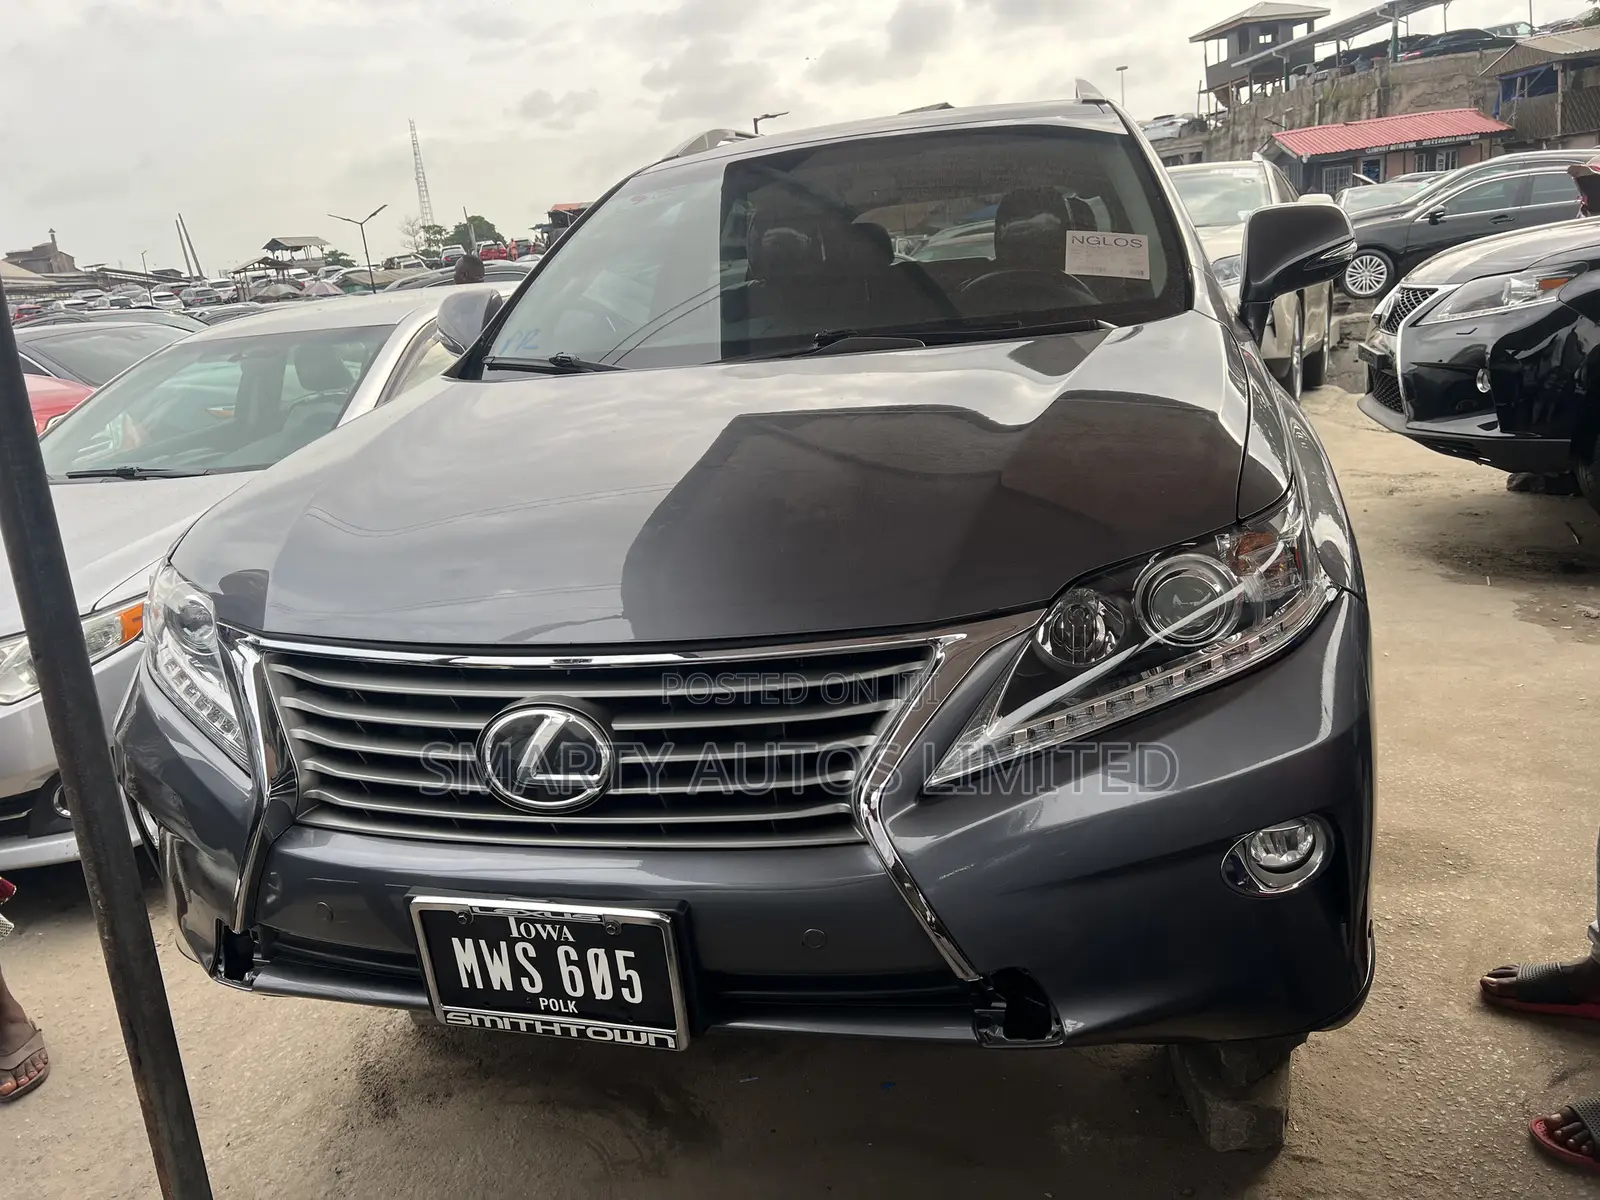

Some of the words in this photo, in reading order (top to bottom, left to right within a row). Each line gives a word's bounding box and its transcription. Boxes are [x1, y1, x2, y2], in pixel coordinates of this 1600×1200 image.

[1071, 235, 1143, 249] NGLOS
[452, 937, 543, 994] MWS
[556, 945, 643, 1004] 605
[539, 997, 579, 1014] POLK
[446, 1012, 677, 1048] SMITHTOWN
